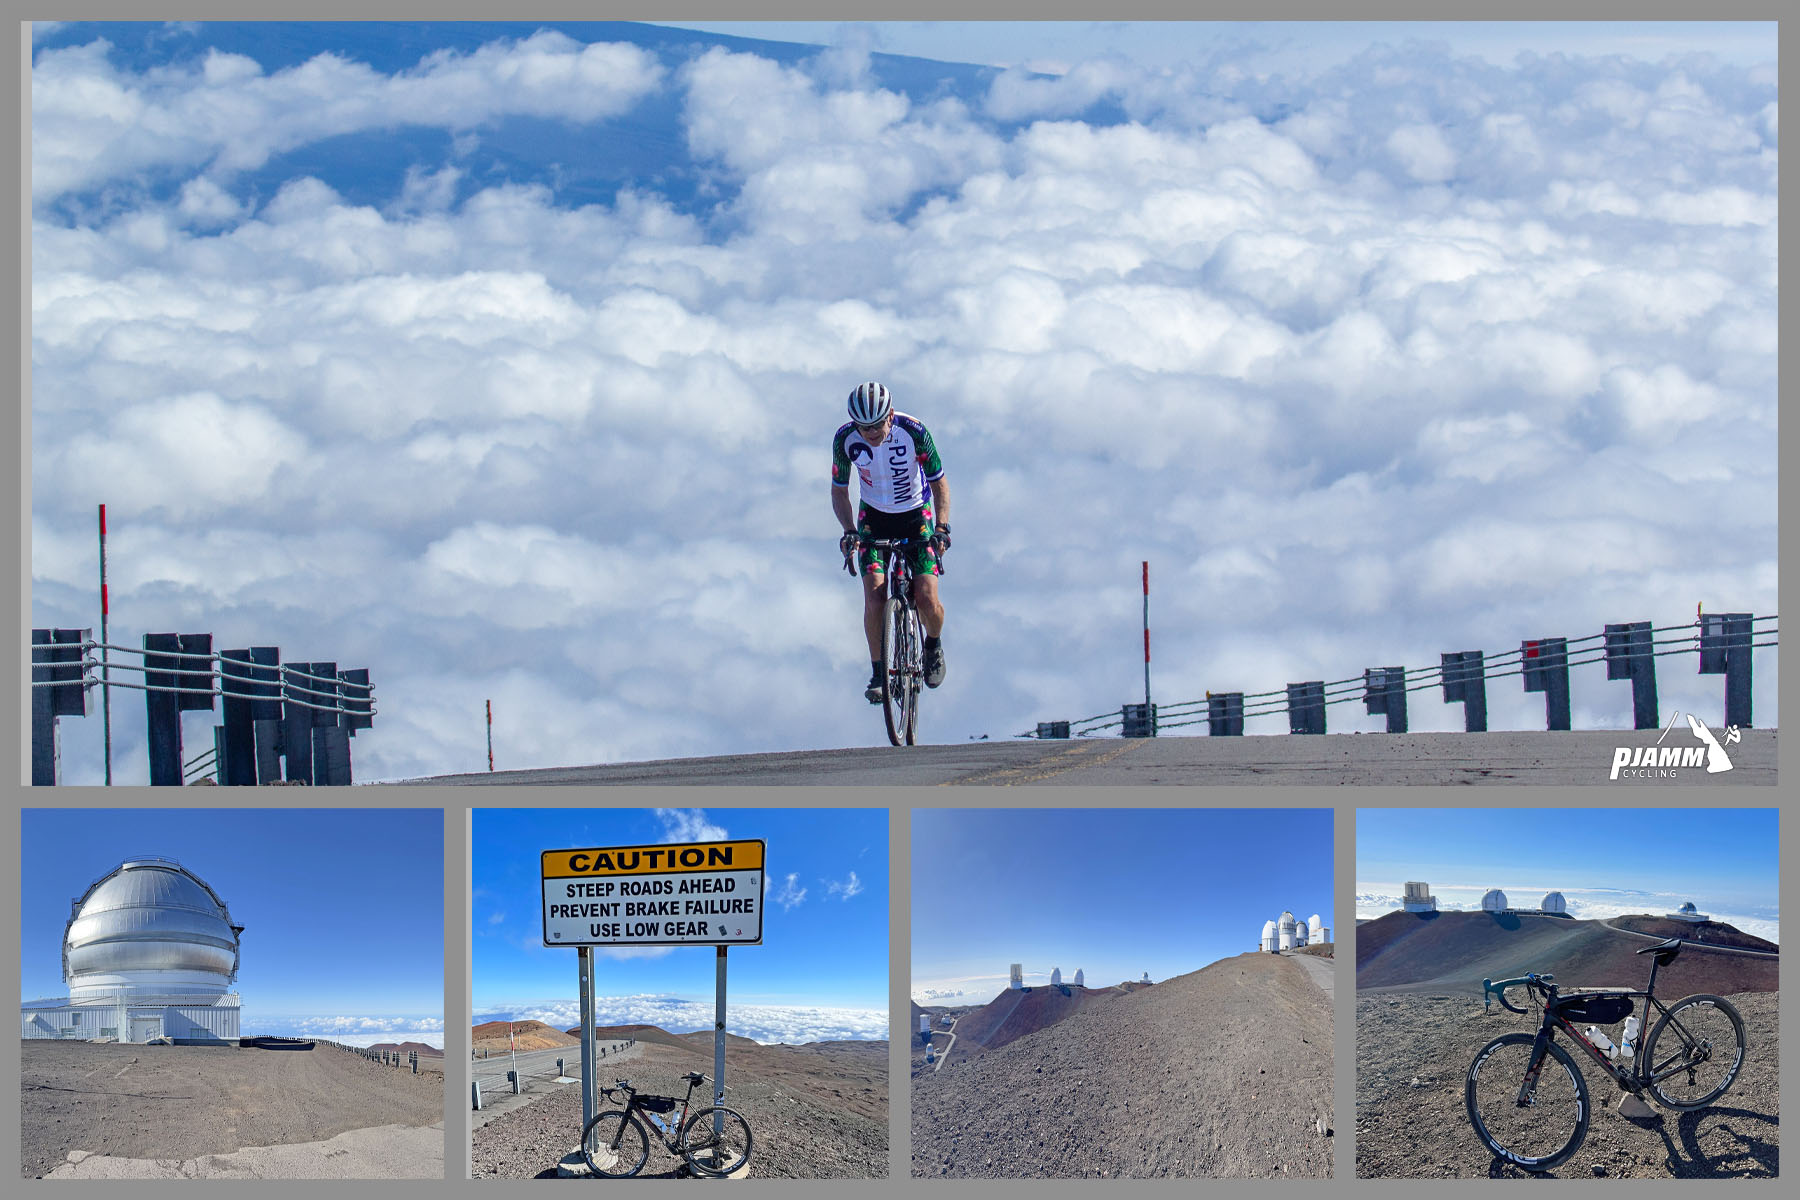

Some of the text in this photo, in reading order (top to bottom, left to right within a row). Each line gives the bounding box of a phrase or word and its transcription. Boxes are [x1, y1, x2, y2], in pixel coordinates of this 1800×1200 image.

[889, 445, 912, 504] PJAMM
[569, 847, 733, 872] CAUTION
[566, 877, 736, 898] STEEP ROADS AHEAD
[551, 898, 754, 918] PREVENT BRAKE FAILURE
[590, 921, 708, 937] USE LOW GEAR
